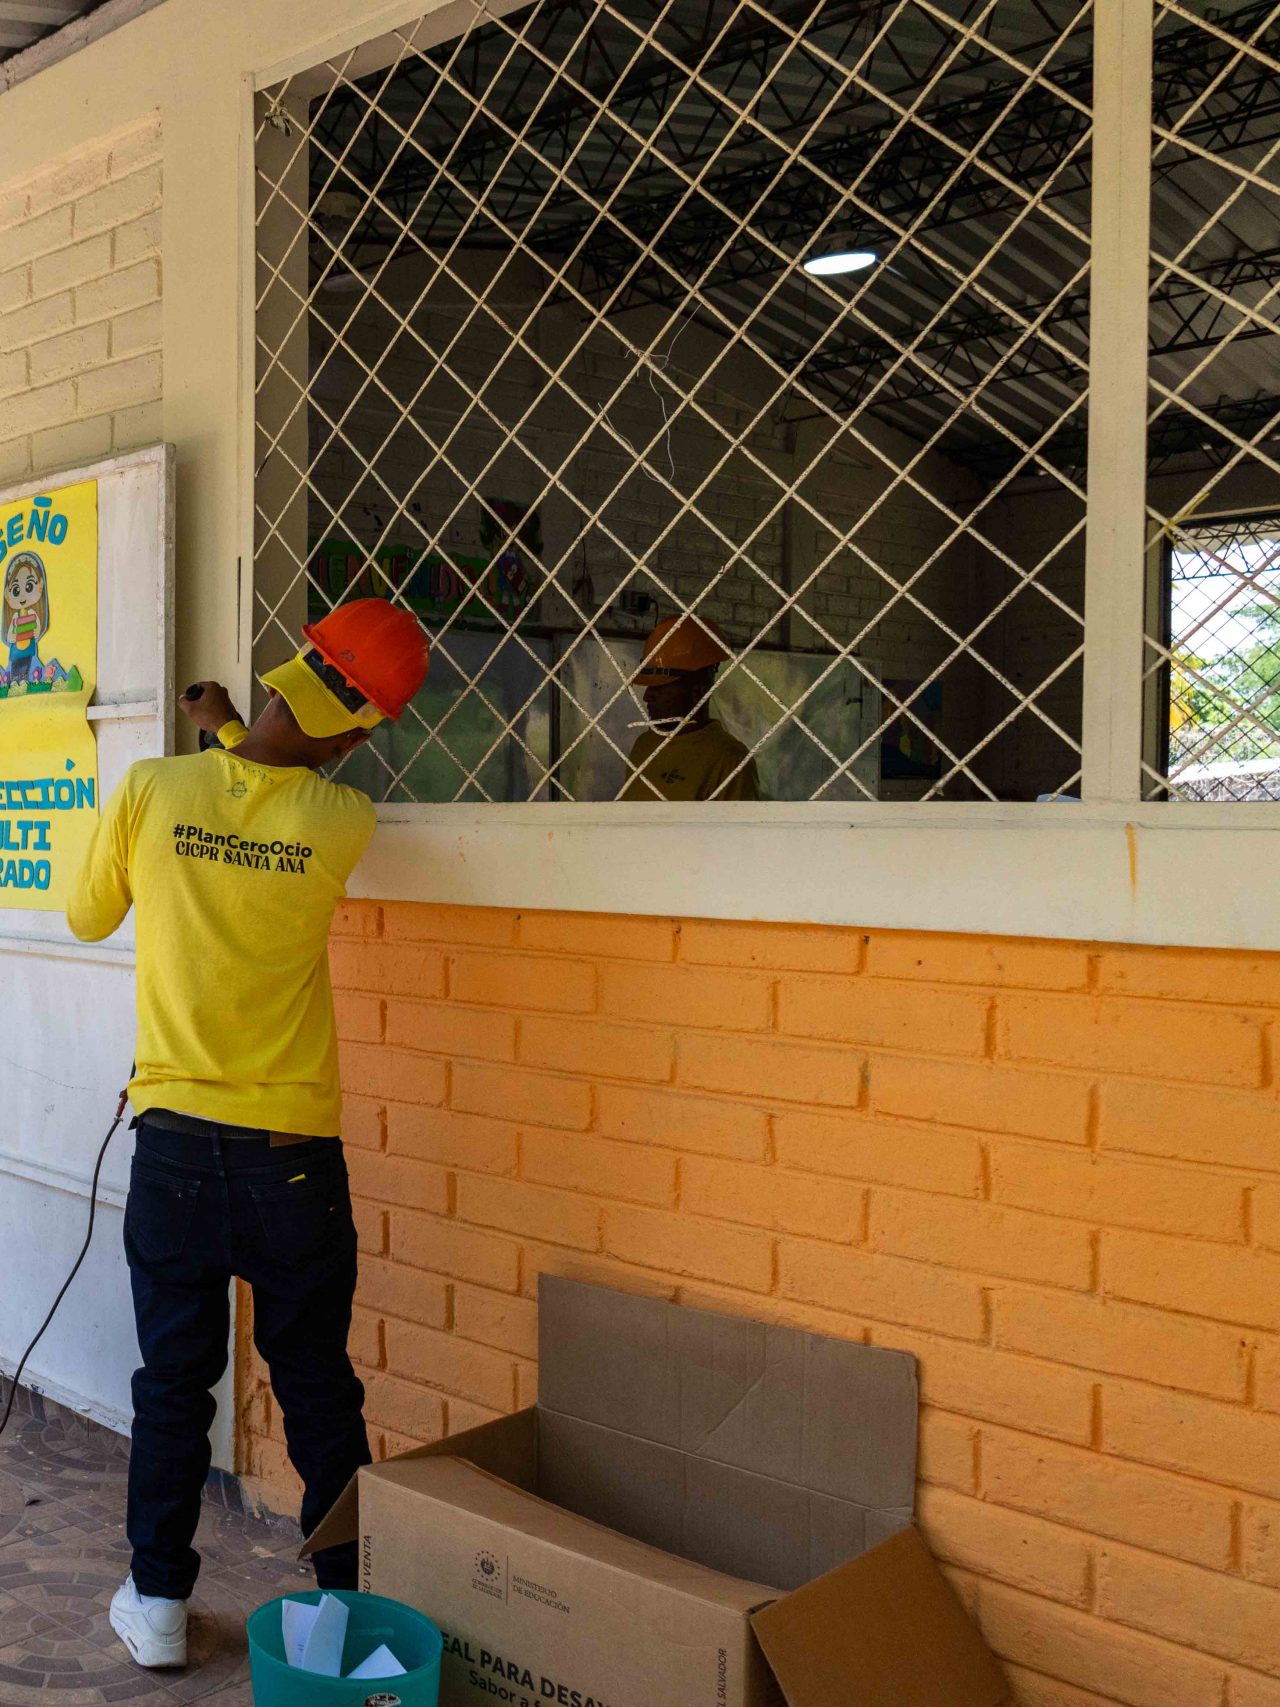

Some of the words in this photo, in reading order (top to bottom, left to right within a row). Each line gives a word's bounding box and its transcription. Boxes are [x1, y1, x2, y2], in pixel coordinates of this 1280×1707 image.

[173, 824, 313, 858] #PlanCeroOcio
[175, 841, 219, 861] CICPR
[223, 849, 271, 870] SANTA
[275, 857, 305, 874] ANA
[363, 1535, 371, 1576] VENTA
[512, 1575, 557, 1598] MINISTERIO
[512, 1585, 523, 1595] DE
[524, 1590, 570, 1614] EDUCACIÓN
[469, 1670, 516, 1703] Sabor
[480, 1649, 534, 1691] PARA
[717, 1648, 727, 1700] SALVADOR
